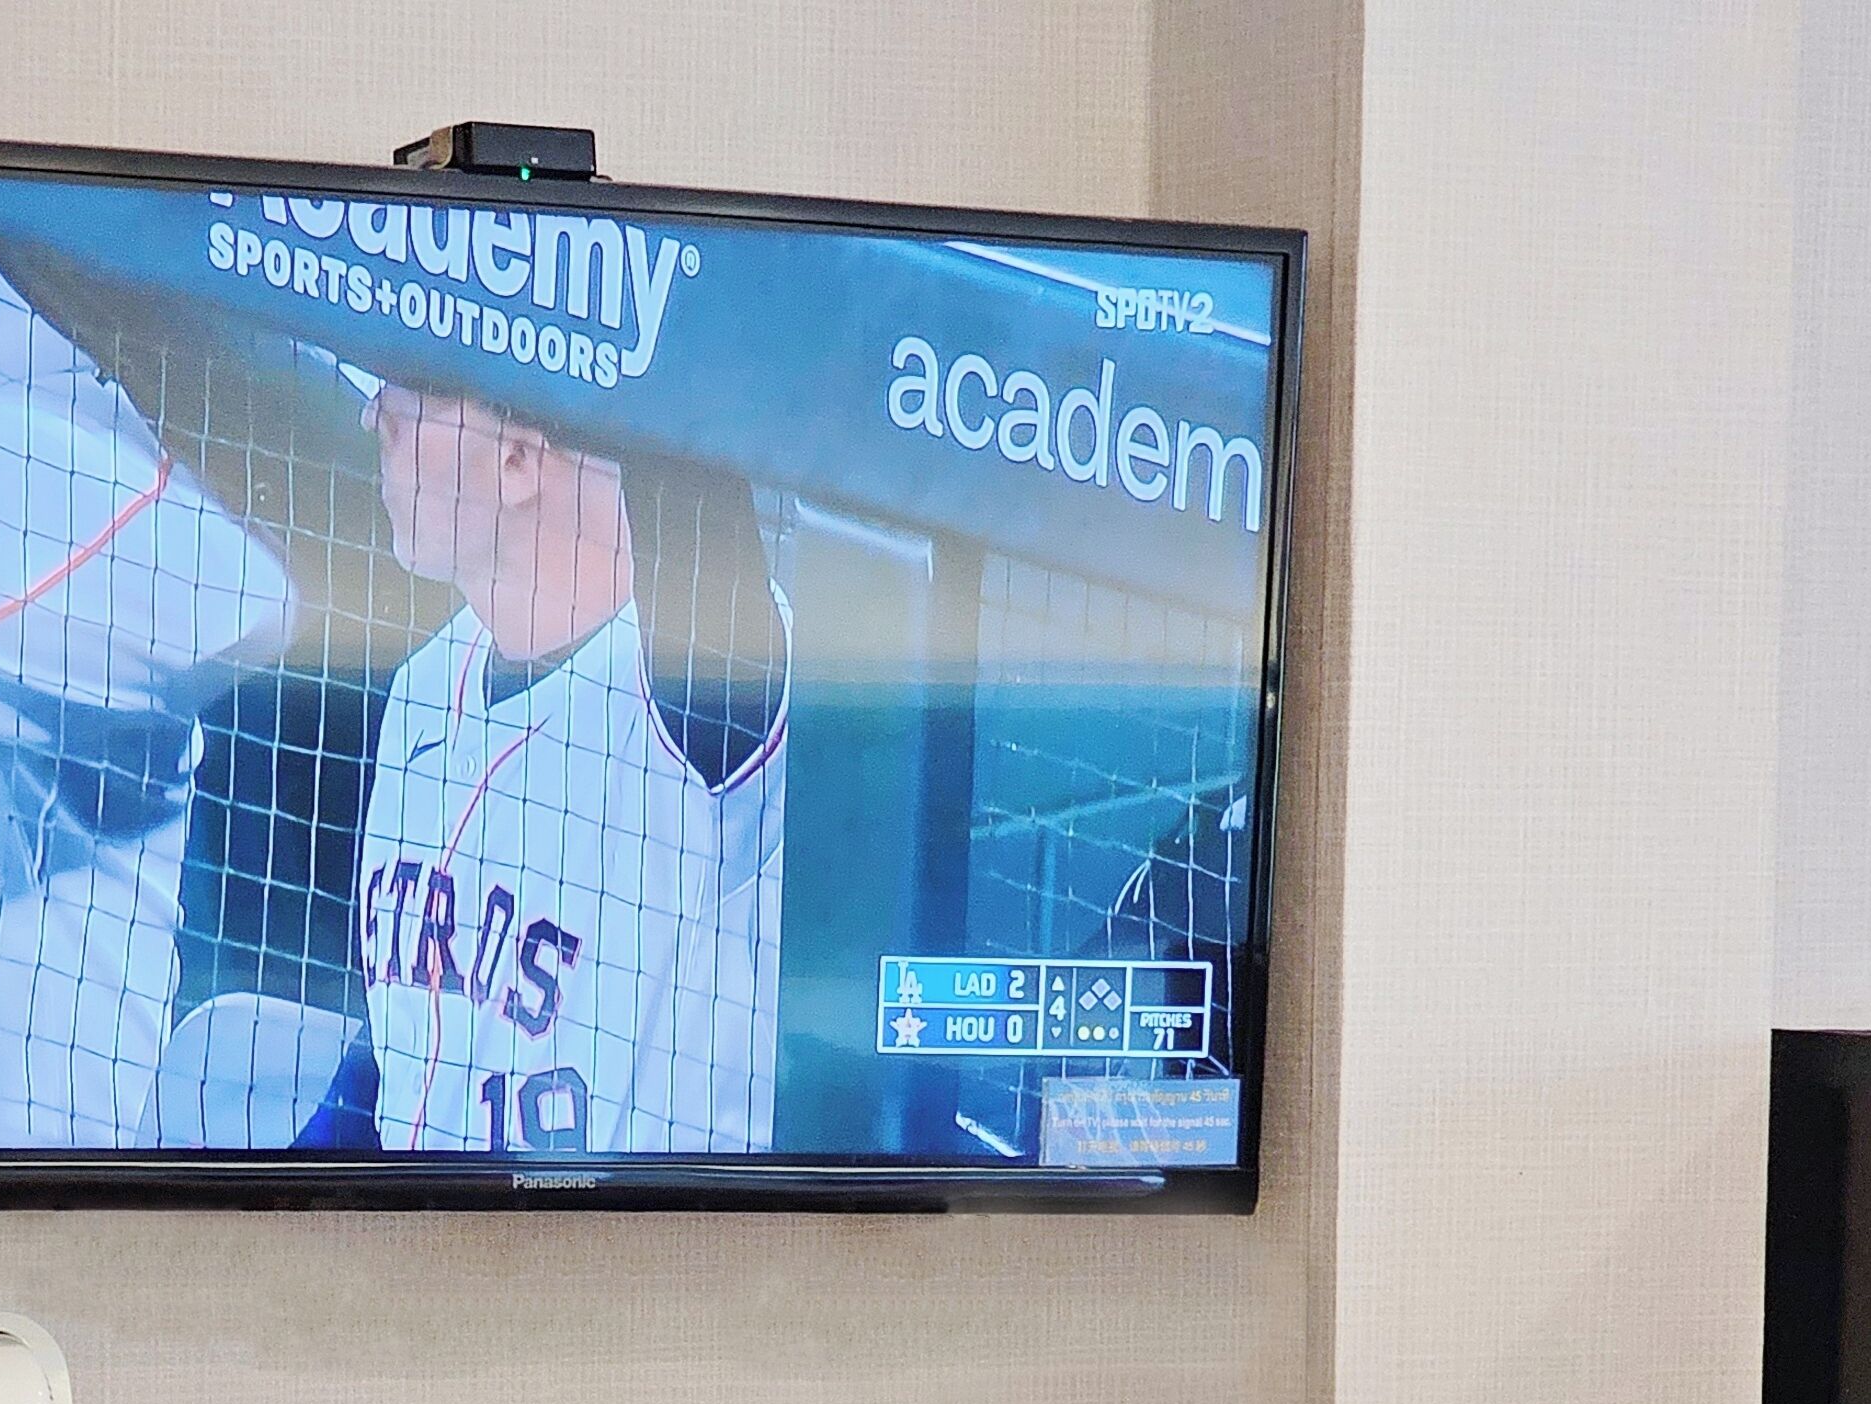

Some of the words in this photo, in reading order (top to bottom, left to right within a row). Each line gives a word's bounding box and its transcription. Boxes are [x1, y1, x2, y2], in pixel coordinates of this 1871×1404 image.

[208, 222, 619, 390] SPORTS+OUTDOORS
[886, 336, 1264, 533] academ
[954, 972, 997, 997] LAD
[1008, 969, 1026, 999] 2
[1048, 996, 1067, 1021] 4
[1139, 1012, 1193, 1029] PITCHES
[945, 1016, 996, 1043] HOU
[1006, 1014, 1025, 1044] 0
[1153, 1028, 1175, 1050] 71
[512, 1173, 597, 1190] Panasonic
